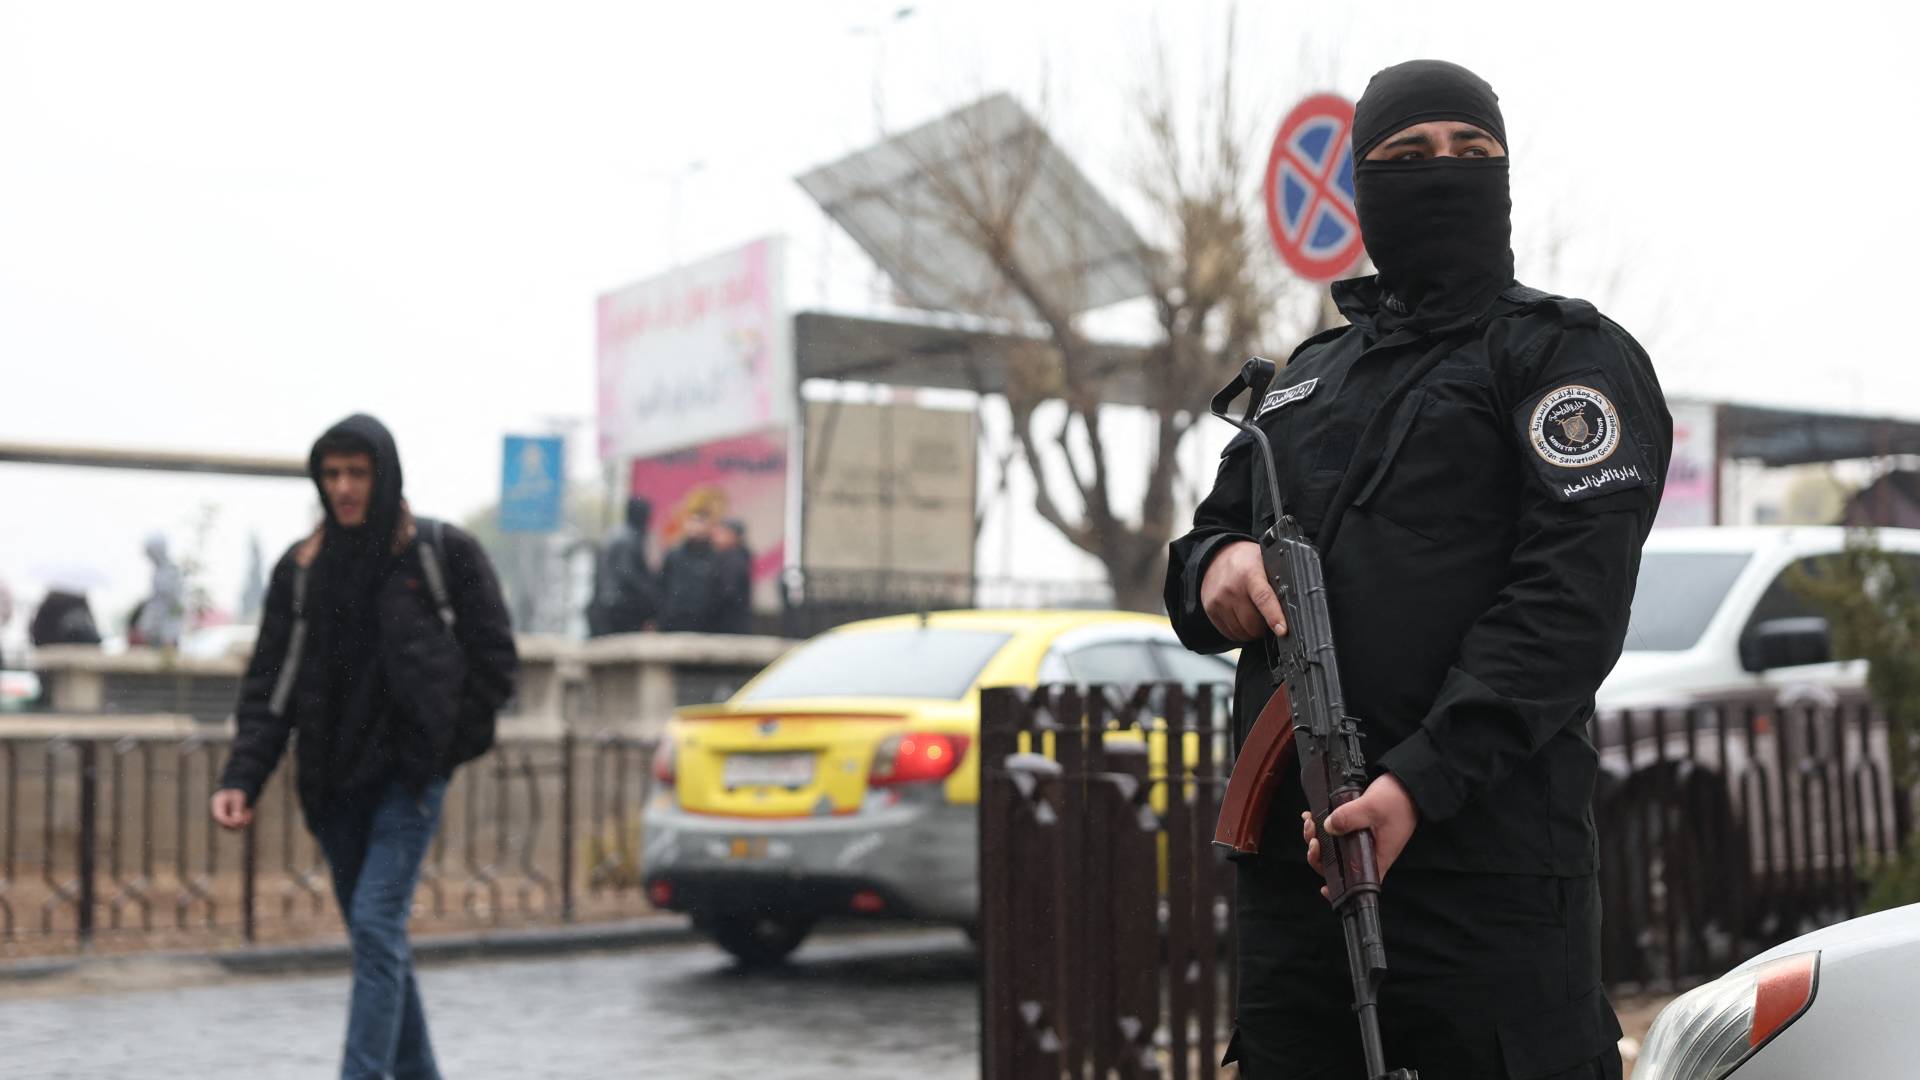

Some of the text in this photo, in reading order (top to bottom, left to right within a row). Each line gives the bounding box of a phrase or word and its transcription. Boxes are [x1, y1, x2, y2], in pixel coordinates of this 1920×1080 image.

[1576, 389, 1602, 405] حكومة
[1532, 402, 1550, 432] السورية
[1537, 415, 1617, 464] Syrian Salvation Government
[1548, 435, 1577, 452] MINISTRY
[1592, 417, 1604, 445] INTERIOR
[1591, 468, 1615, 487] الأمن
[1613, 464, 1642, 481] إدارة
[1563, 475, 1592, 497] العام
